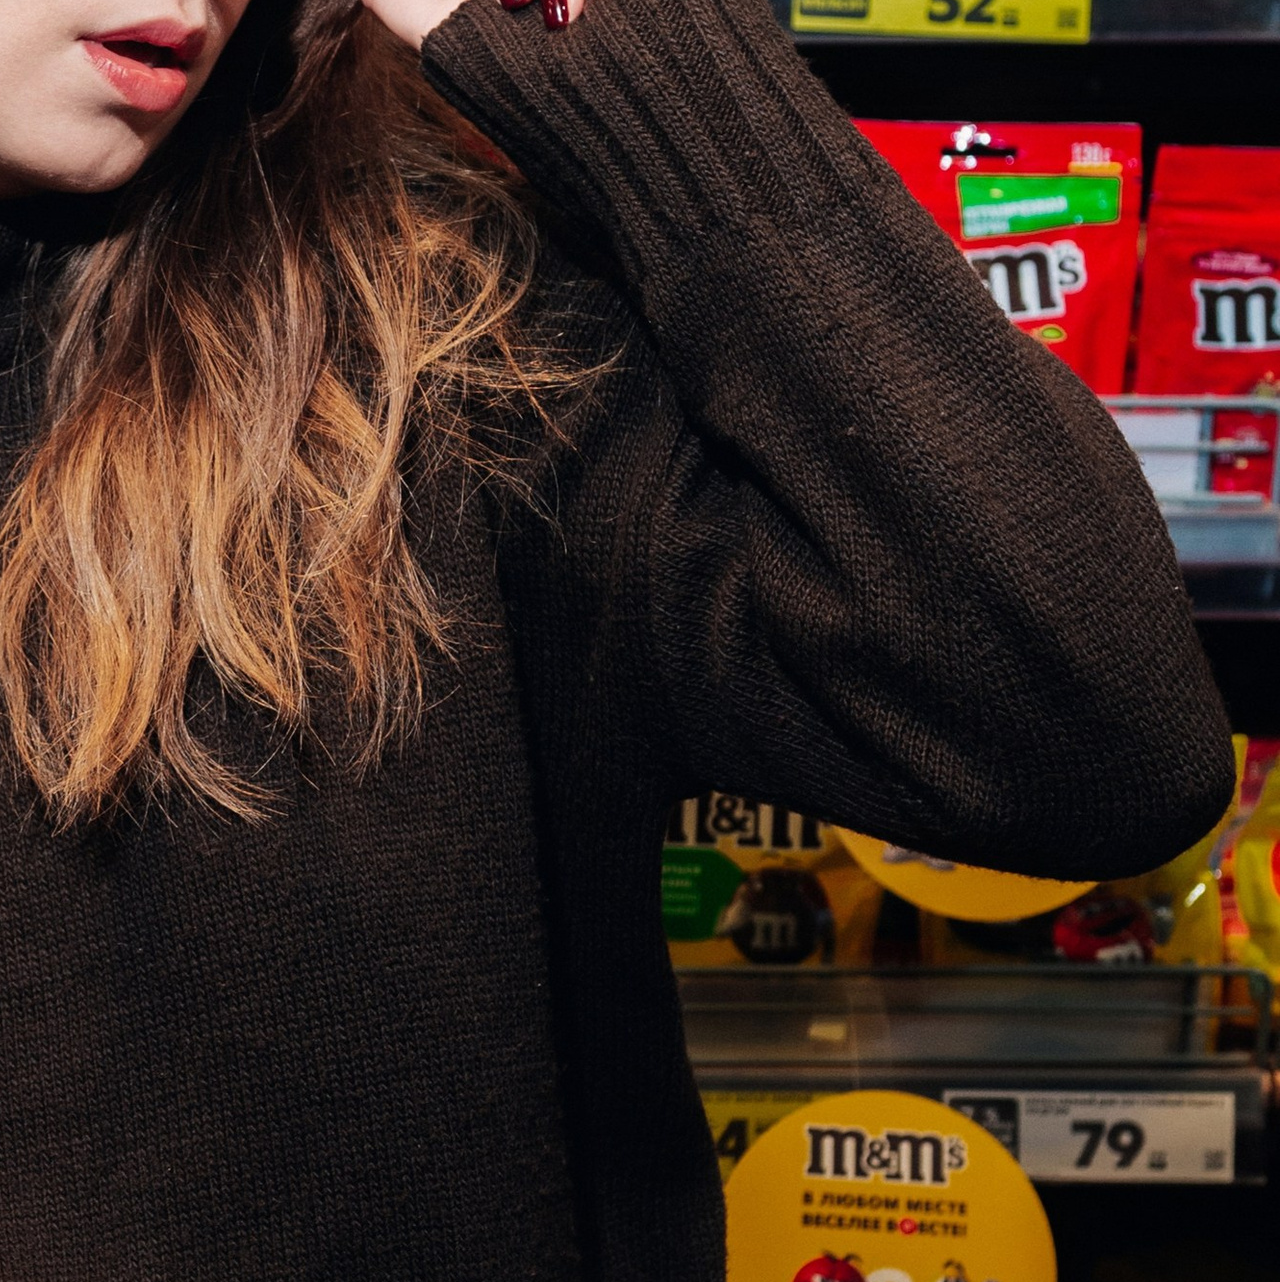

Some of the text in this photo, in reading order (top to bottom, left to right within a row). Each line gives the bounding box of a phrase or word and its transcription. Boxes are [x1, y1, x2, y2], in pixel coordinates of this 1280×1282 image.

[1070, 1119, 1146, 1169] 79
[802, 1191, 968, 1216] В ЛЮБОМ МЕСТЕ
[802, 1212, 881, 1232] ВЕСЕЛЕЕ
